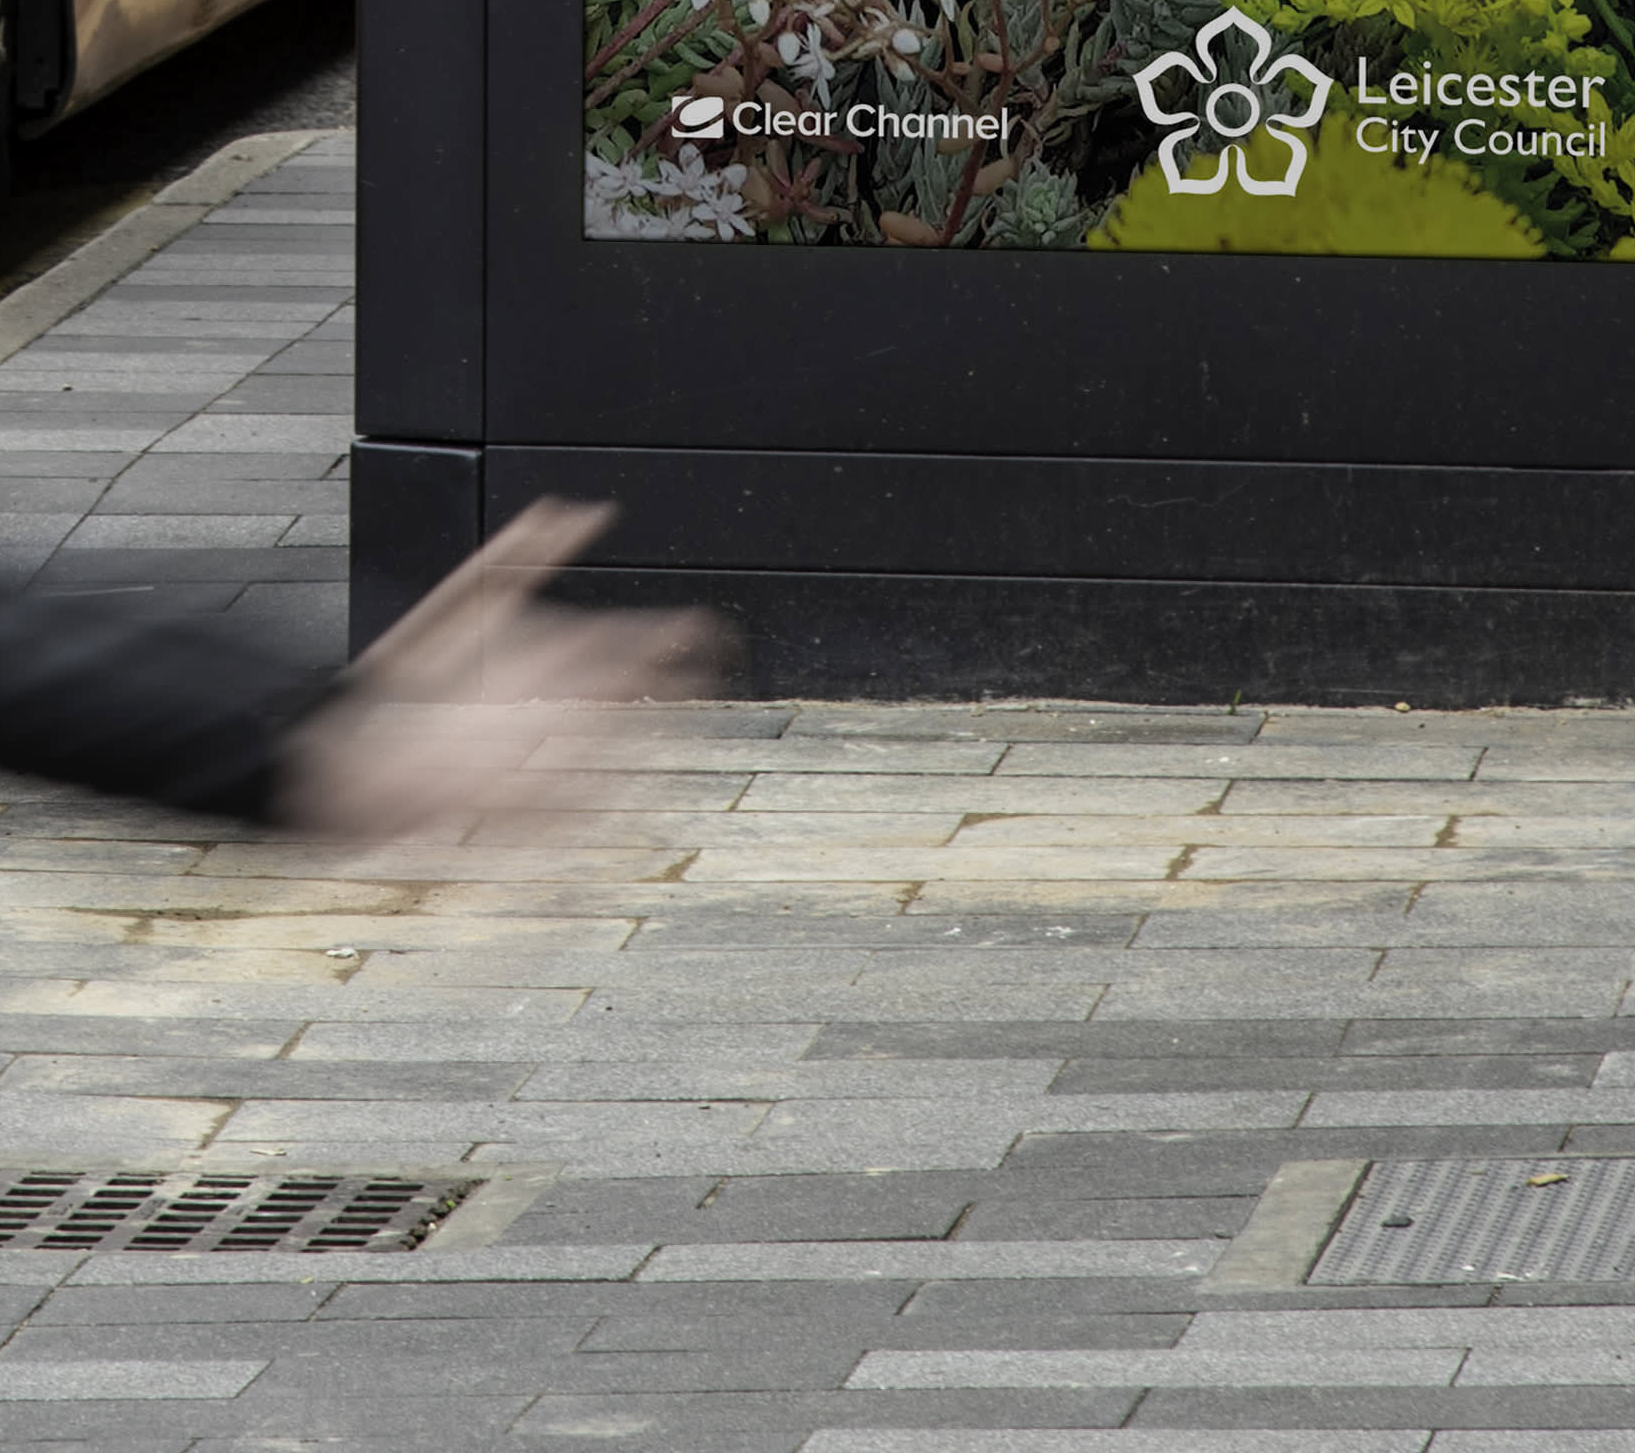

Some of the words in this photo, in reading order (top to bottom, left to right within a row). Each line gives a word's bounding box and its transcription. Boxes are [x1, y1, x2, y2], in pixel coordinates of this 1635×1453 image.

[1356, 55, 1607, 109] Leicester
[733, 101, 838, 137] Clear
[846, 104, 1009, 140] Channel
[1356, 116, 1440, 165] City
[1454, 119, 1607, 158] Council
